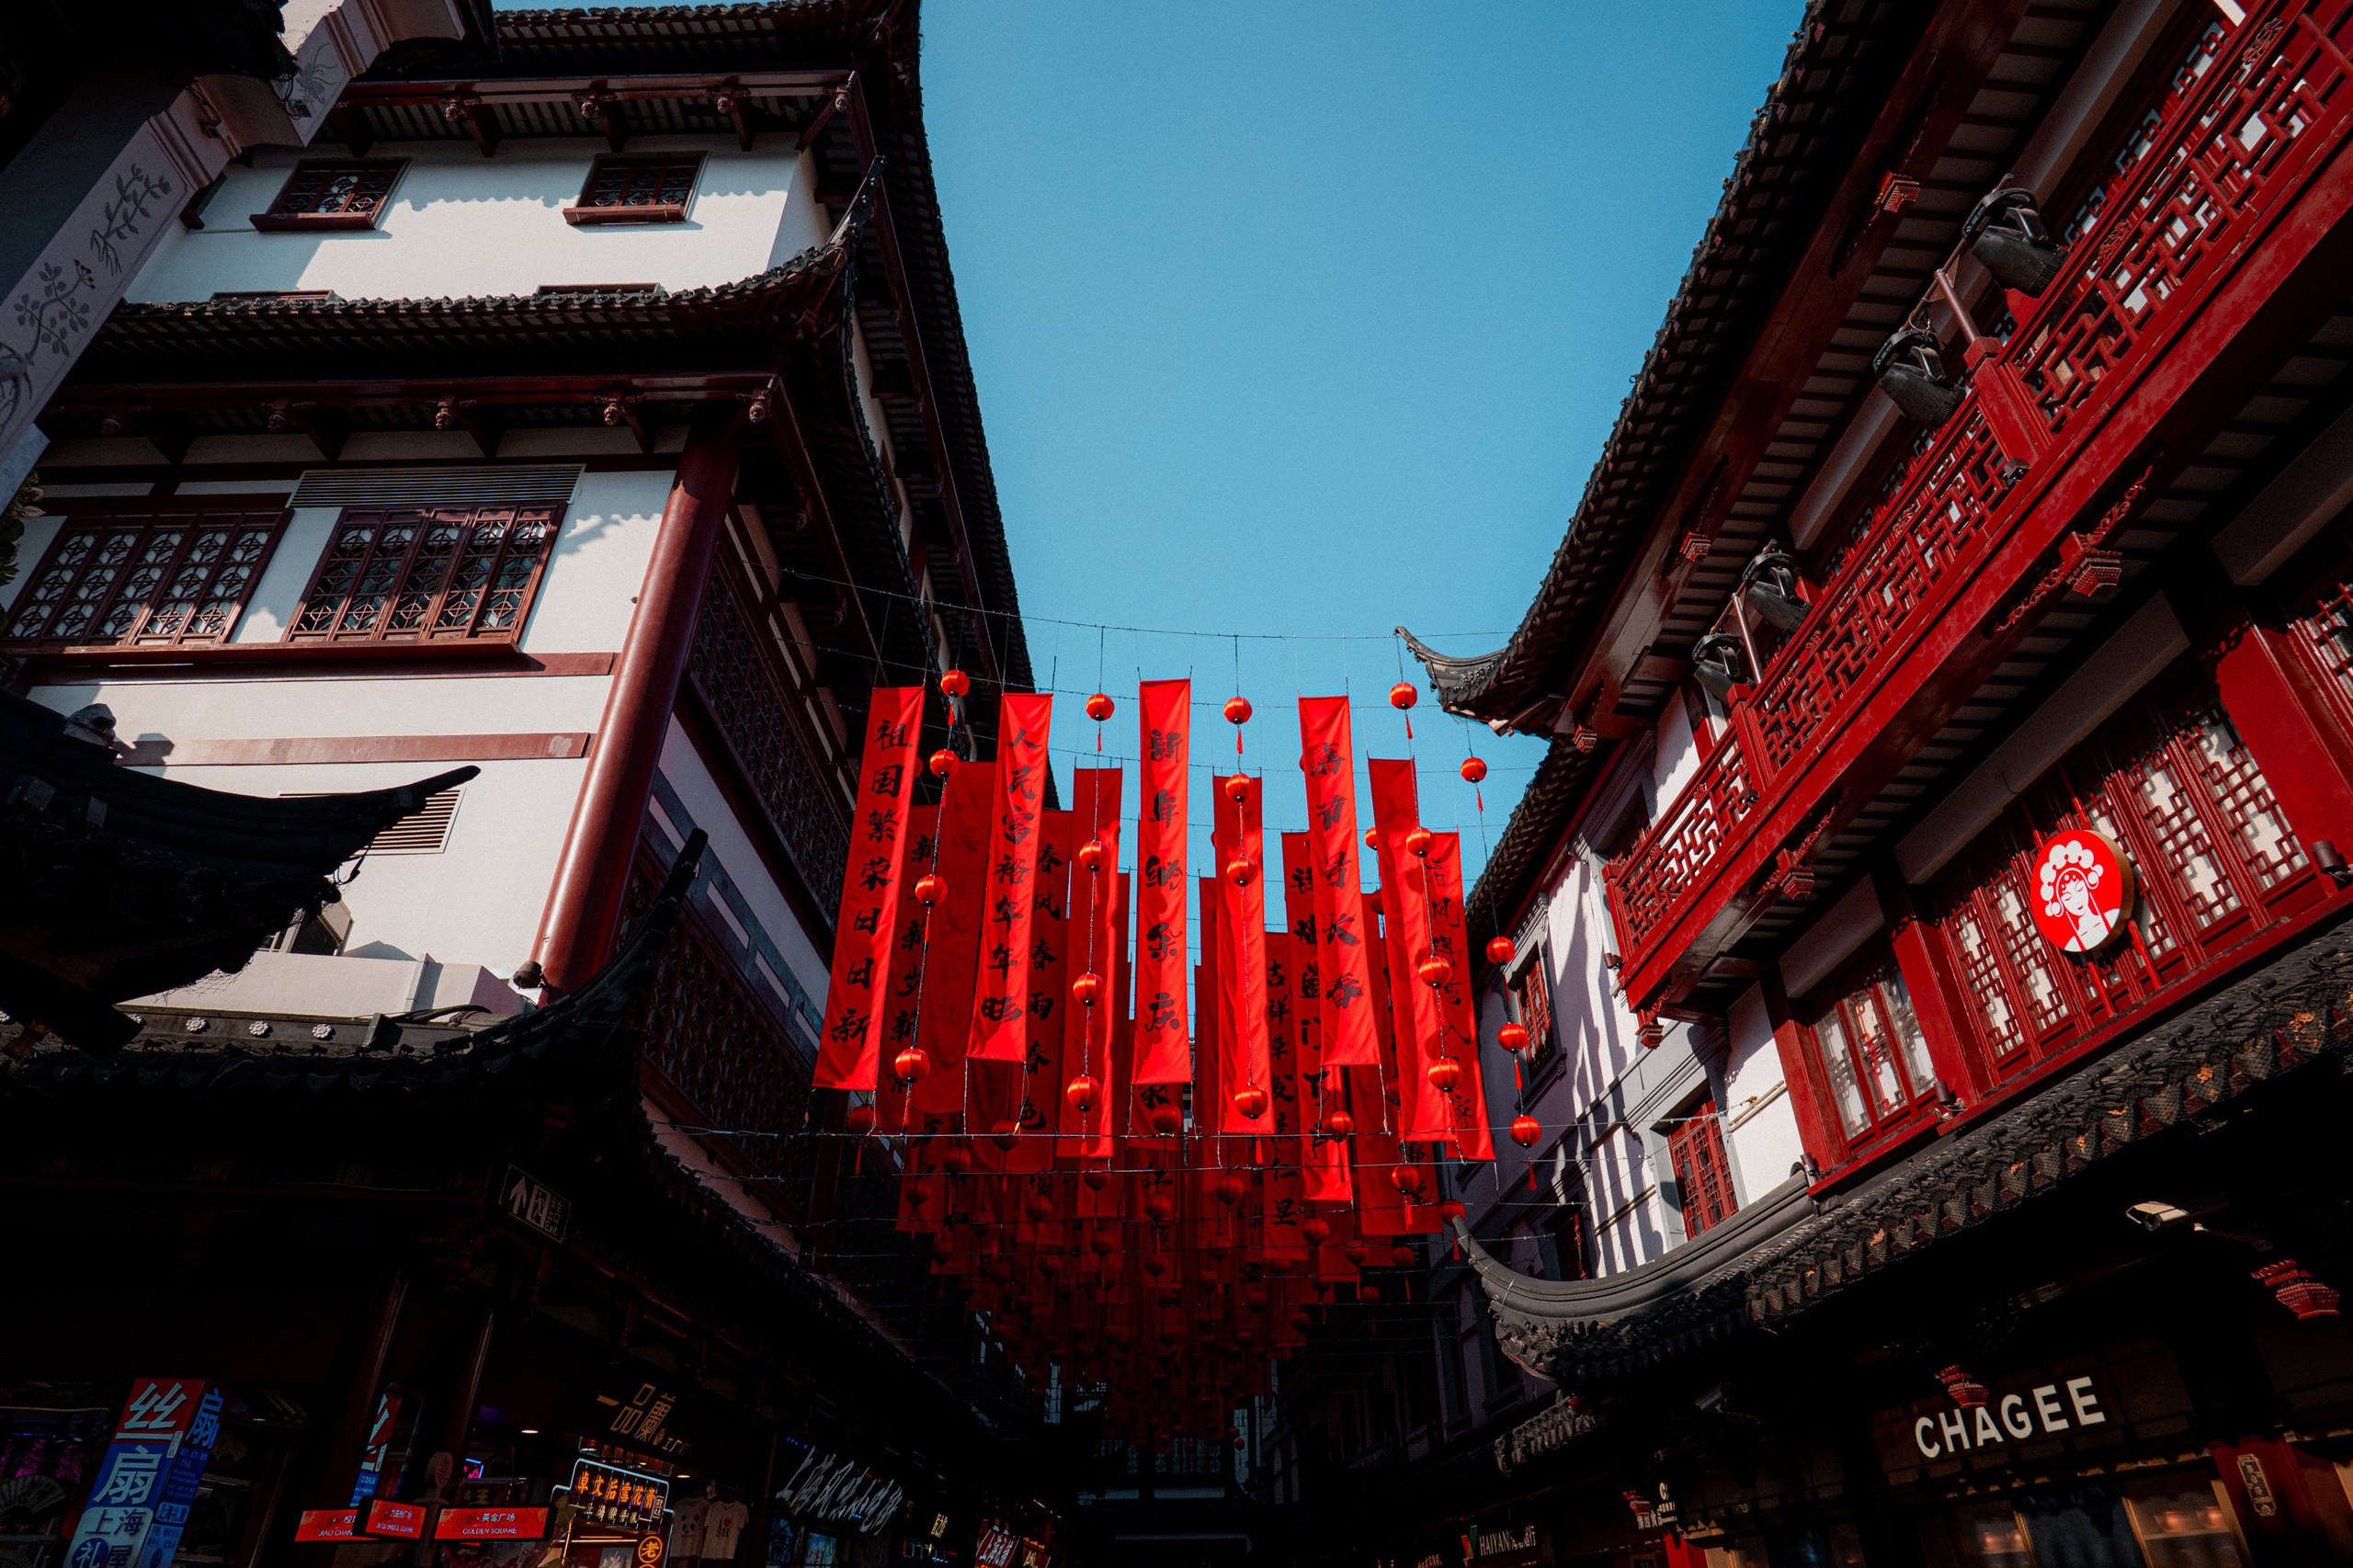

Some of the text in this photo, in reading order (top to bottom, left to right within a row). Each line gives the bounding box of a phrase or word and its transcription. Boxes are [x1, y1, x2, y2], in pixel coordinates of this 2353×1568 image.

[831, 720, 912, 1050] 祖国繁荣日日新
[185, 1388, 224, 1449] 扇
[1915, 1375, 2107, 1459] CHAGEE
[93, 1382, 187, 1505] 丝扇
[85, 1508, 146, 1537] 上海
[482, 1512, 516, 1523] 黄金广场
[491, 1527, 517, 1535] SQUARE
[716, 1528, 730, 1538] SH
[641, 1540, 660, 1559] 老
